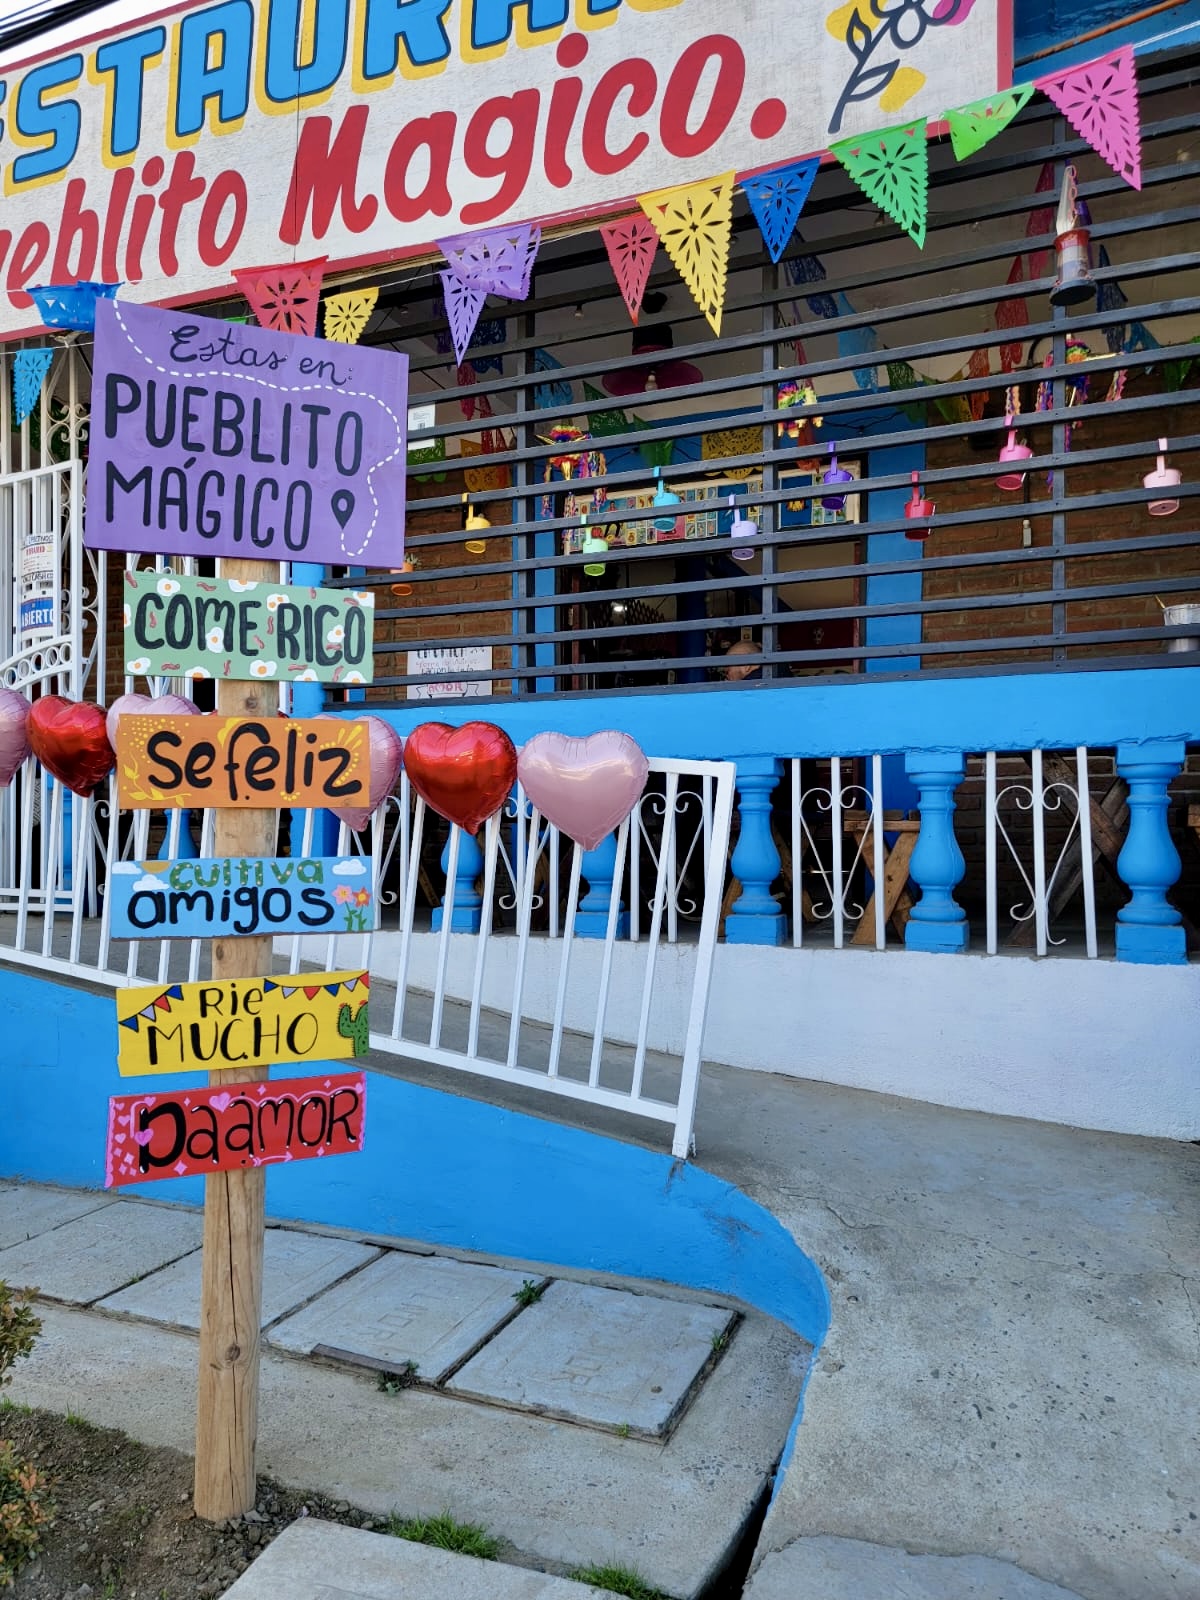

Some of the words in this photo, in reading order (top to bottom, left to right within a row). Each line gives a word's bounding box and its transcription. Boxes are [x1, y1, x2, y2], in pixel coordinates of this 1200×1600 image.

[279, 33, 787, 246] Magico.
[168, 325, 288, 370] Estas
[104, 373, 364, 477] PUEBLITO
[106, 457, 313, 552] MÁGICO
[135, 593, 262, 657] COME
[276, 602, 366, 666] RICO
[169, 858, 324, 891] cultiva
[127, 886, 335, 934] amigos
[147, 1012, 318, 1065] MUCHO
